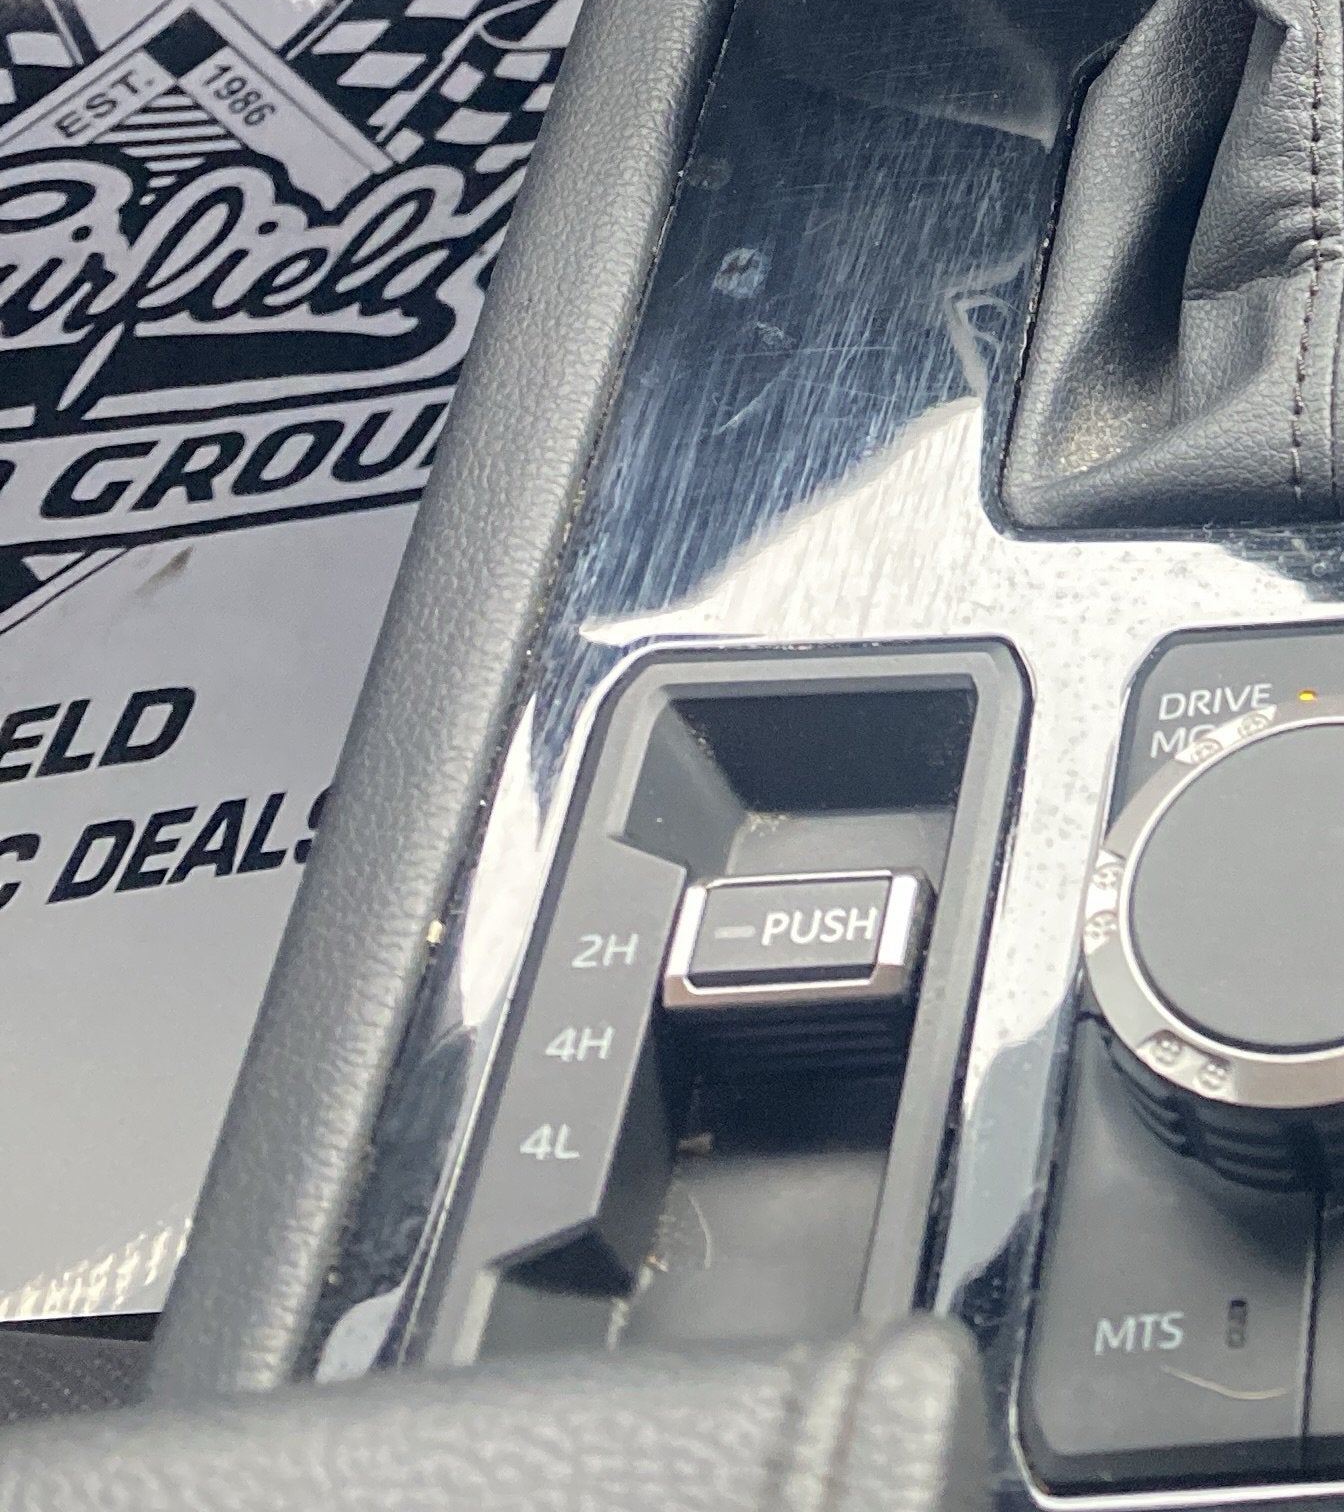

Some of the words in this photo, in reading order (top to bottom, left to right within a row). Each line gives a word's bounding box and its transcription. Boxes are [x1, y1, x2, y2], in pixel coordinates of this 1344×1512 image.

[55, 69, 155, 138] EST.
[203, 62, 277, 126] 1986
[40, 402, 449, 520] GROU
[1158, 683, 1273, 721] DRIVE
[761, 907, 878, 946] PUSH
[571, 933, 639, 969] 2H
[545, 1026, 615, 1062] 4H
[519, 1122, 581, 1160] 4L
[1094, 1311, 1186, 1356] MTS
